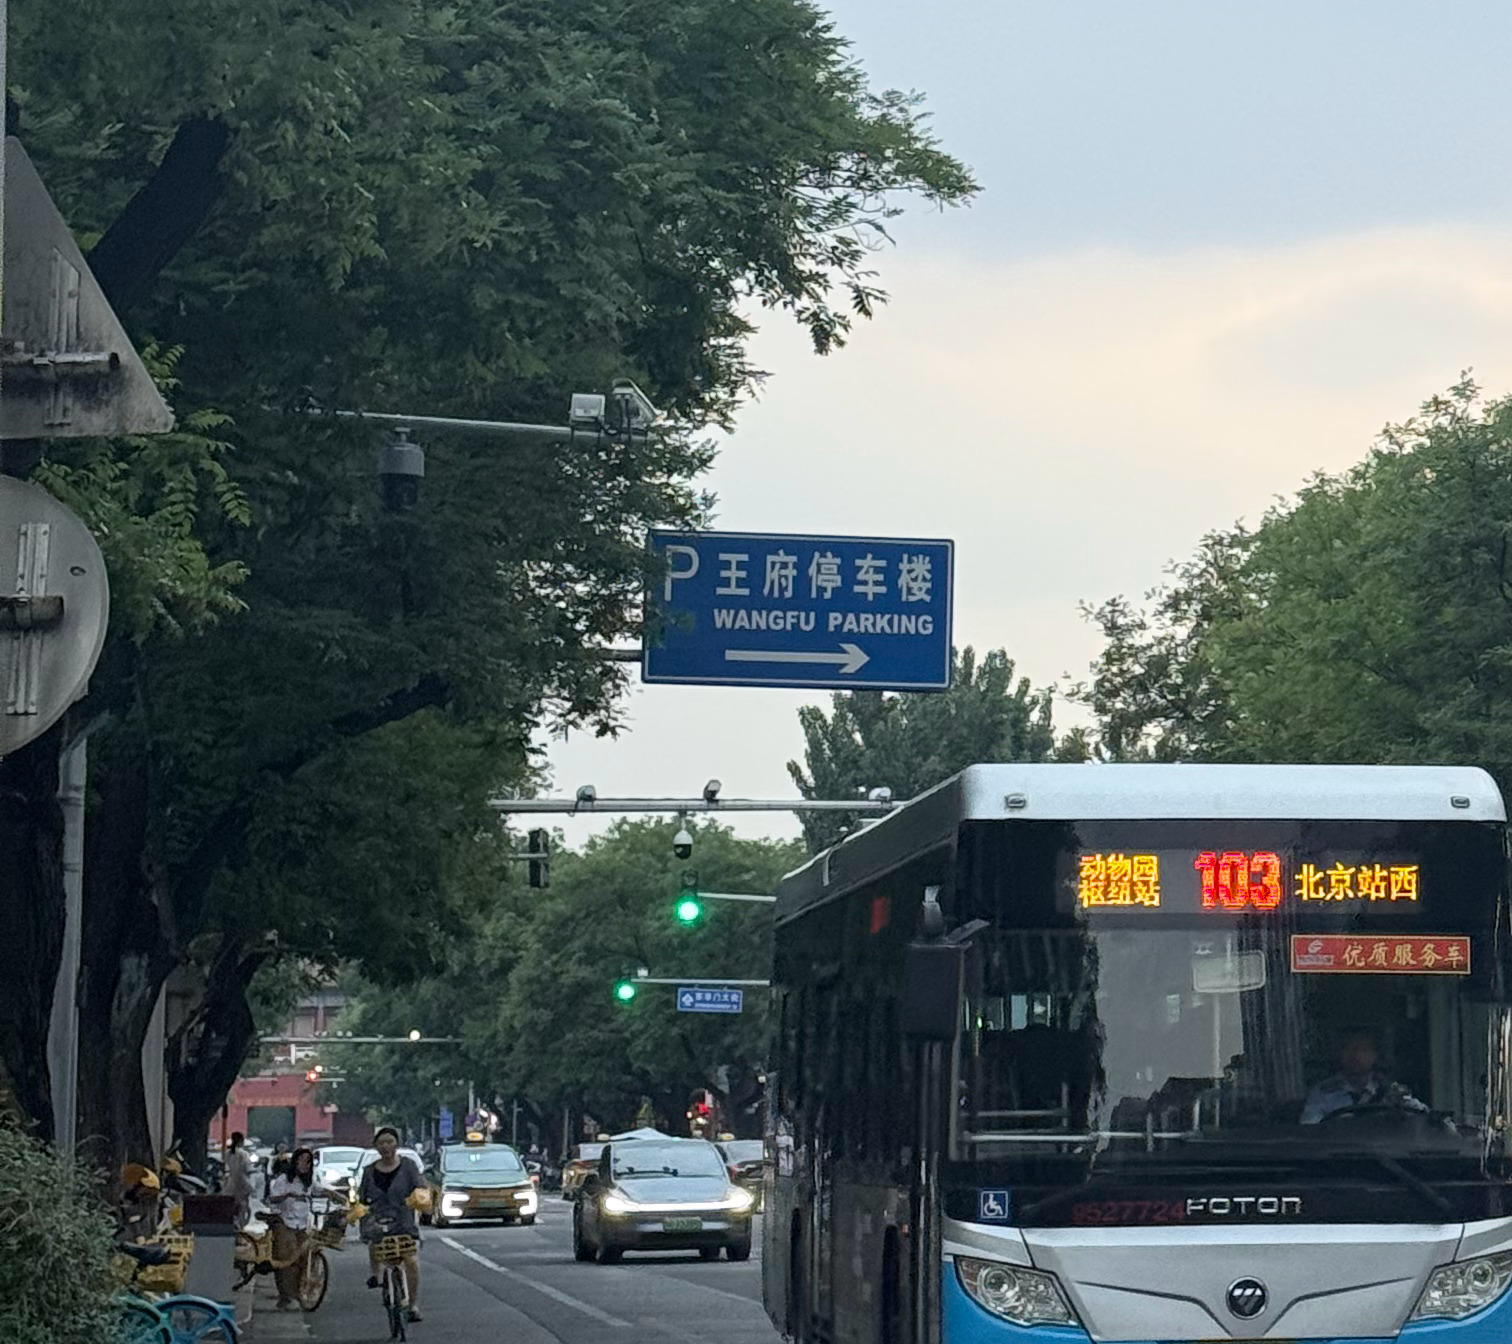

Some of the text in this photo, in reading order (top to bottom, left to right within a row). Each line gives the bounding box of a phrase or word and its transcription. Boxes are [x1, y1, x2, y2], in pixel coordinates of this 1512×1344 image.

[664, 544, 700, 601] P
[715, 549, 933, 603] 王府停车楼
[713, 608, 934, 636] WANGFU PARKING
[1079, 853, 1159, 881] 动物园
[1194, 851, 1281, 910] 103
[1295, 862, 1418, 901] 北京站西
[1078, 878, 1161, 908] 枢纽站
[1186, 1197, 1301, 1215] FOTON
